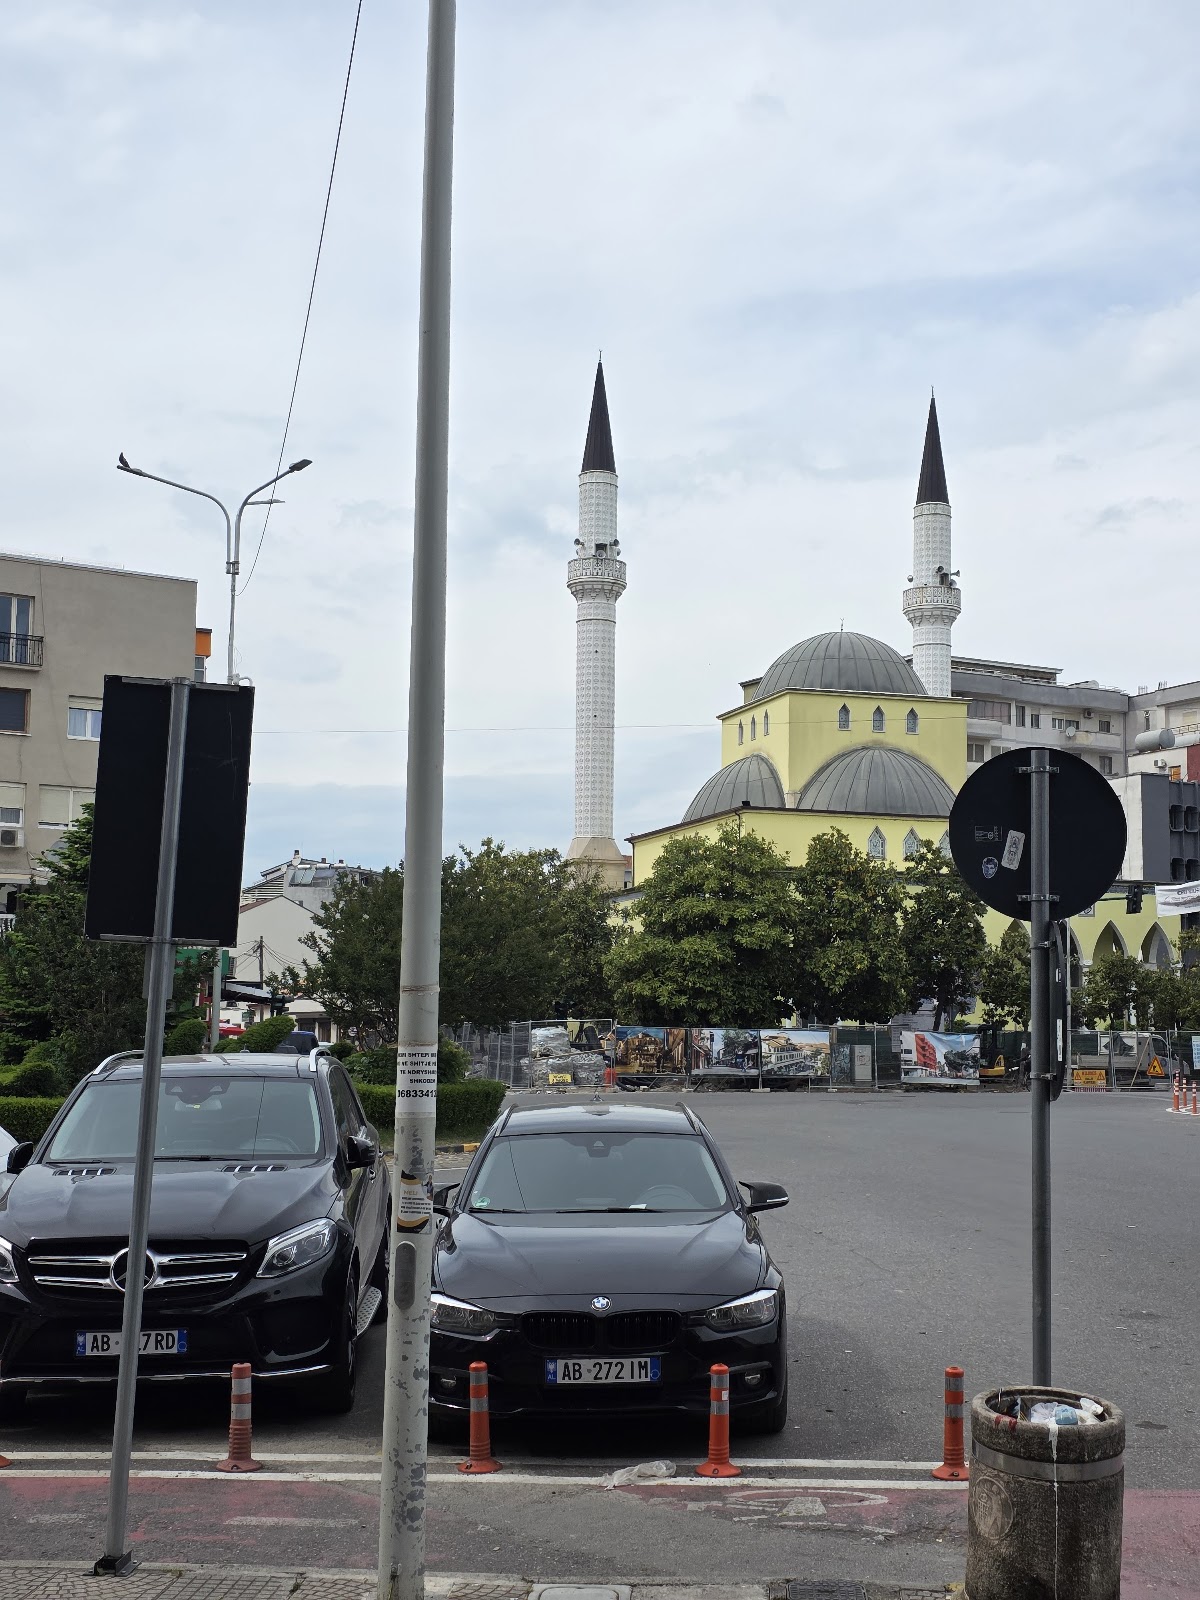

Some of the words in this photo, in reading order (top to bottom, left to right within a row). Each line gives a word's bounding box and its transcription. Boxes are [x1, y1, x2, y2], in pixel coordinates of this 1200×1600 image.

[91, 1335, 111, 1352] AB
[562, 1362, 582, 1380] AB
[593, 1361, 624, 1380] 272
[630, 1360, 648, 1379] IM
